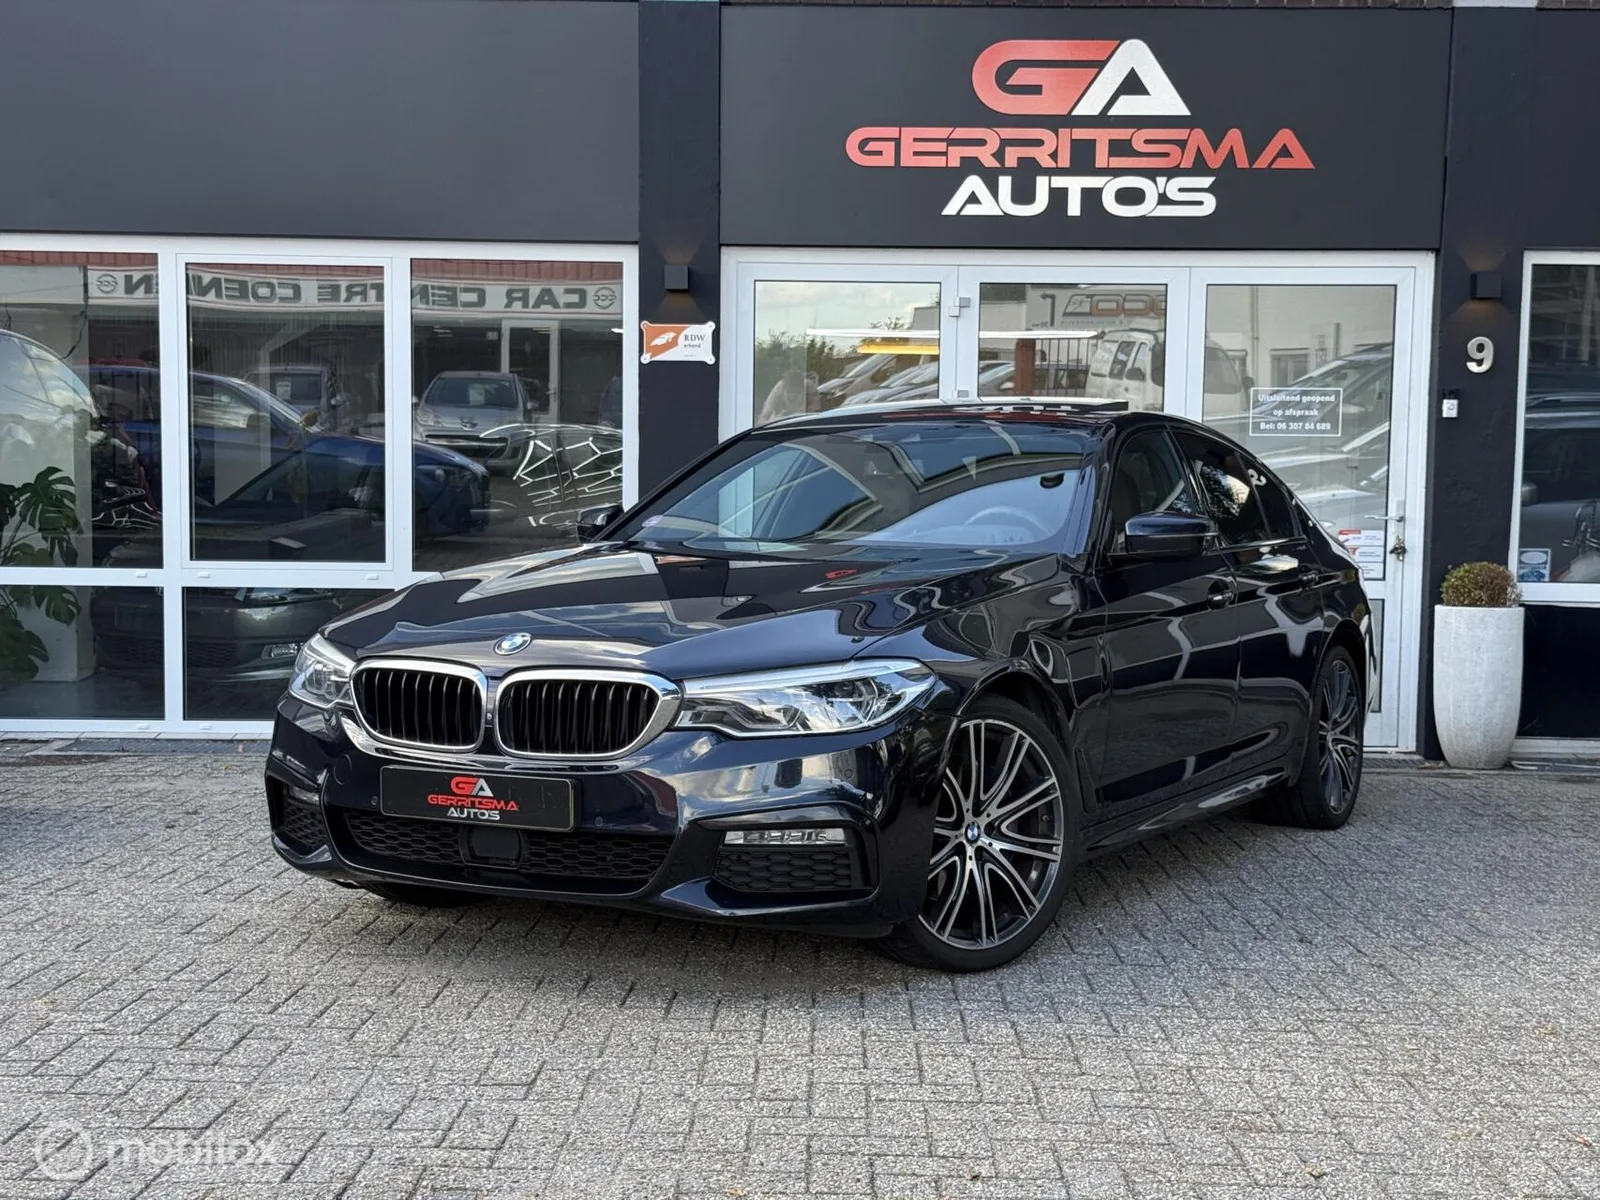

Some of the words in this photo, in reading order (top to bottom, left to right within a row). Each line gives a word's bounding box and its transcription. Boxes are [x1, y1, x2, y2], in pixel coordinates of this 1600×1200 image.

[972, 38, 1191, 116] GA
[845, 127, 1315, 169] GERRITSMA
[941, 175, 1217, 217] AUTO'S
[684, 333, 706, 342] RDW
[1465, 336, 1495, 374] 9
[1302, 394, 1336, 403] geopend
[1273, 409, 1283, 417] op
[1284, 408, 1319, 417] afspraak
[450, 776, 495, 797] GA
[427, 794, 520, 811] GERRITSMA
